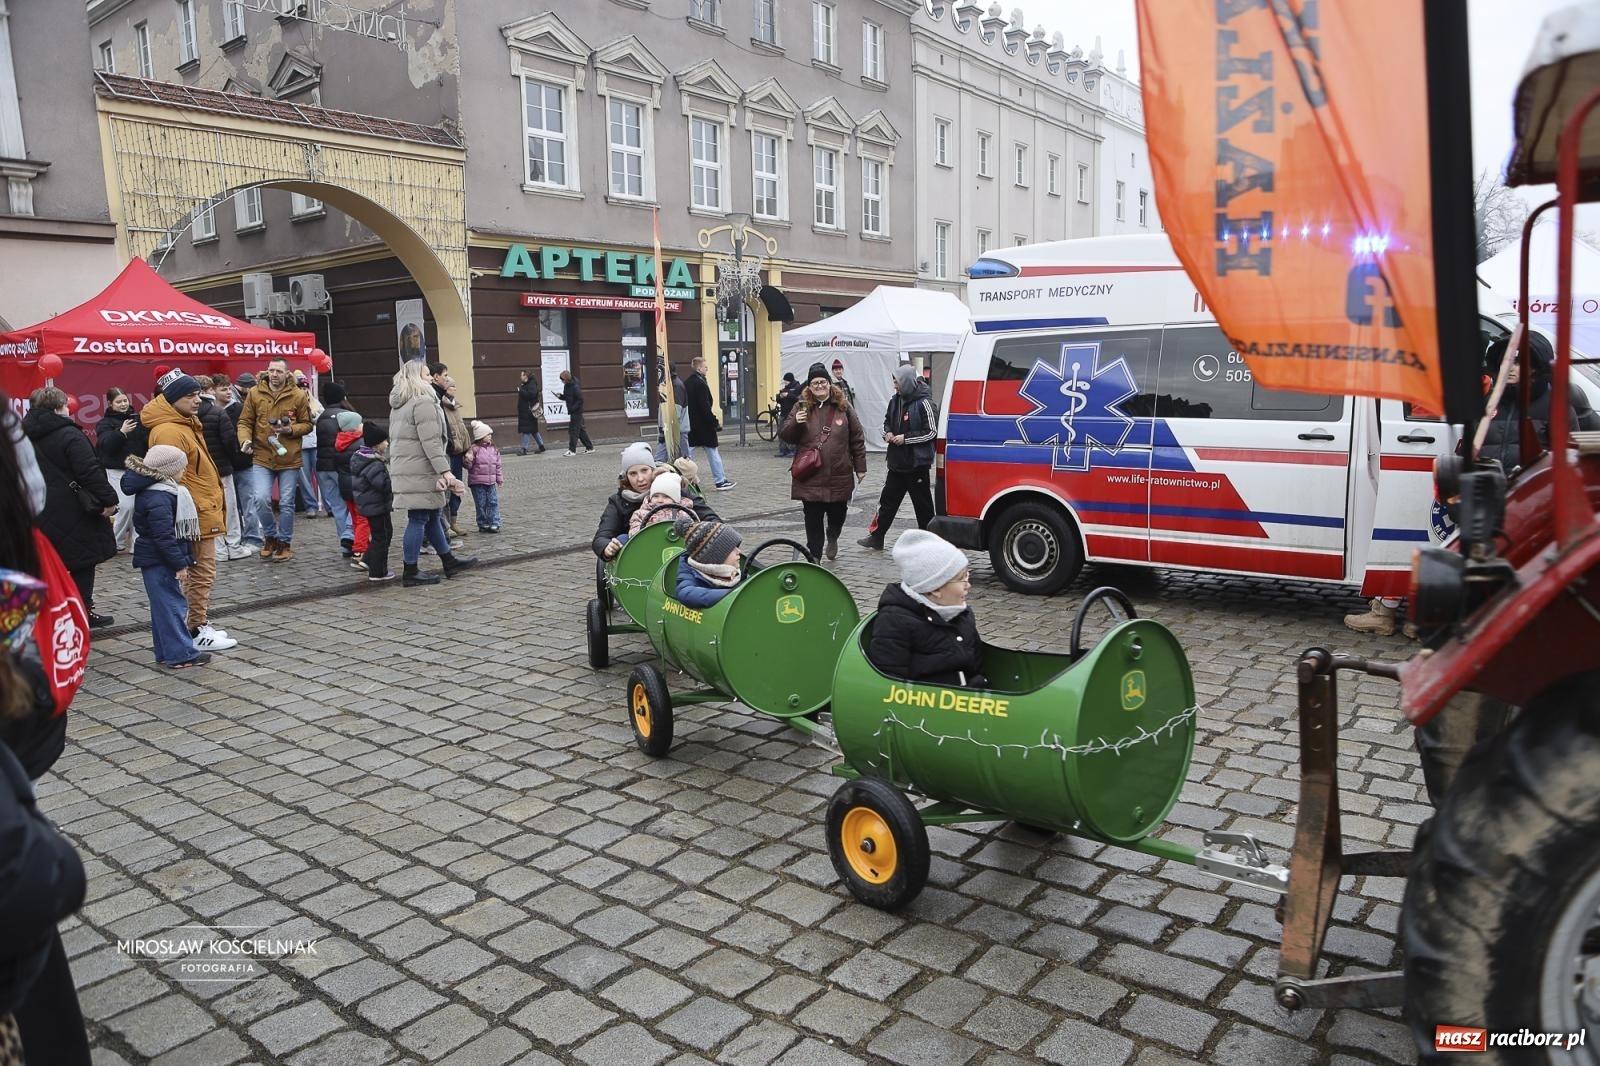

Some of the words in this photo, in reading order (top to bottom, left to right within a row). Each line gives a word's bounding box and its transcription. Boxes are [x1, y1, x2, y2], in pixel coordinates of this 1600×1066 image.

[501, 243, 695, 288] APTEKA
[635, 287, 655, 297] POD
[663, 288, 692, 298] ÓŻAMI
[980, 288, 1043, 302] TRANSPORT
[1048, 284, 1114, 298] MEDYCZNY
[527, 295, 556, 306] RYNEK
[559, 297, 568, 306] 12
[575, 298, 613, 309] CENTRUM
[614, 300, 679, 311] FARMACEUTZNE
[99, 309, 204, 324] DKMS
[0, 343, 17, 358] awcą
[73, 337, 154, 354] Zostań
[159, 338, 229, 356] Dawcą
[234, 340, 299, 358] szpiku!
[1225, 370, 1252, 383] 505
[547, 405, 564, 415] NFZ
[1107, 473, 1221, 490] www.life-ratownictwo.pl
[661, 598, 679, 615] JOHN
[678, 604, 704, 624] DEERE
[883, 685, 935, 706] JOHN
[939, 690, 1009, 718] DEERE
